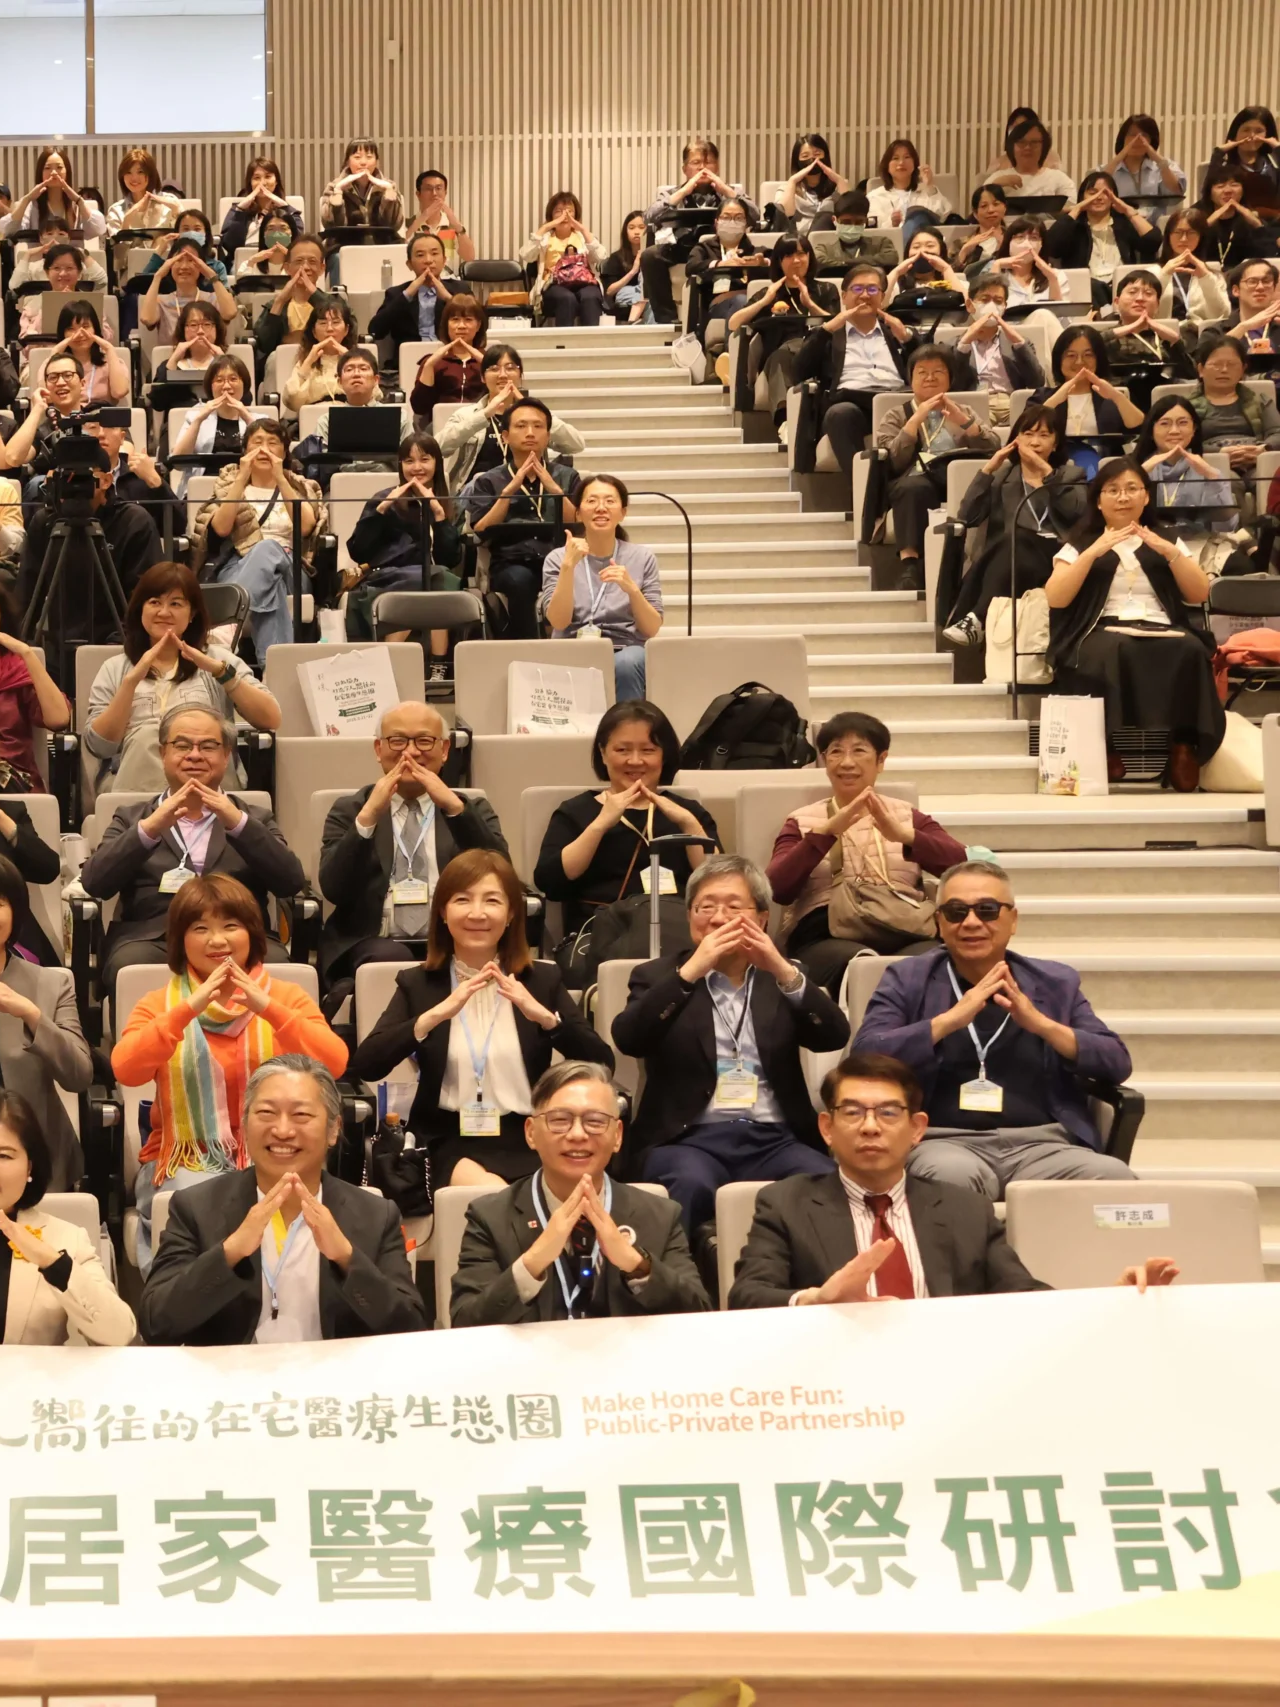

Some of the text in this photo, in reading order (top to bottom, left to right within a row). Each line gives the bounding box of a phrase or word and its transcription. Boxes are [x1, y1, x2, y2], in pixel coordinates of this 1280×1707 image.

[1115, 1210, 1154, 1221] 許志成
[582, 1385, 843, 1413] Make Home Care Fun:
[584, 1405, 905, 1436] Public-Private Partnership
